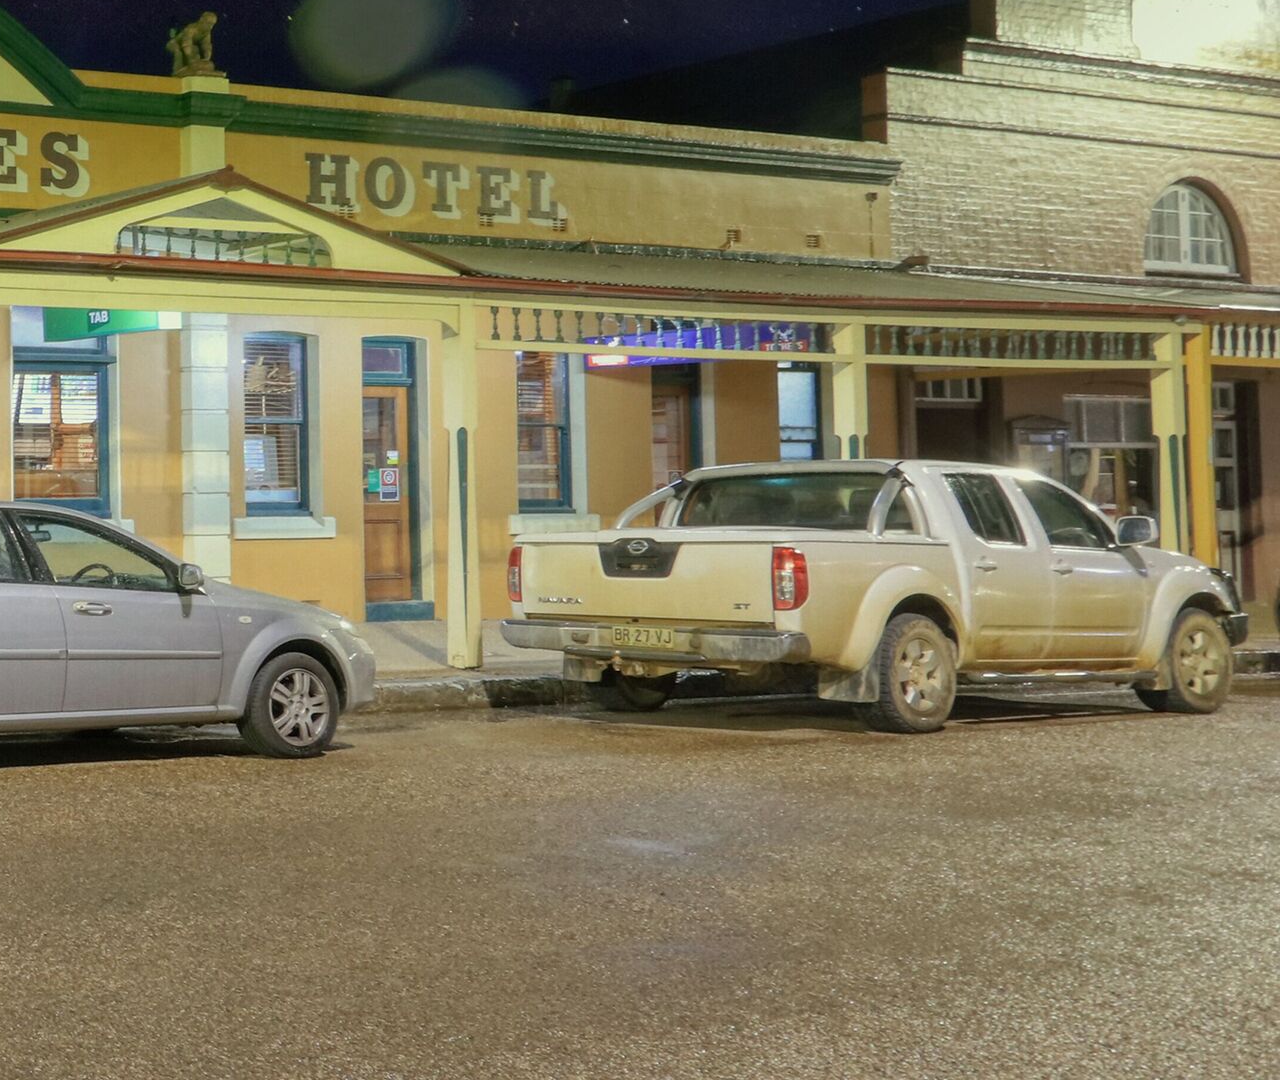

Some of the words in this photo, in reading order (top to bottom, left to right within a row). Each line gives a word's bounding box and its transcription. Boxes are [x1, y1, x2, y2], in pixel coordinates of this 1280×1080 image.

[305, 152, 568, 226] HOTEL
[88, 311, 109, 324] TAB
[615, 628, 630, 642] BR
[635, 629, 650, 643] 27
